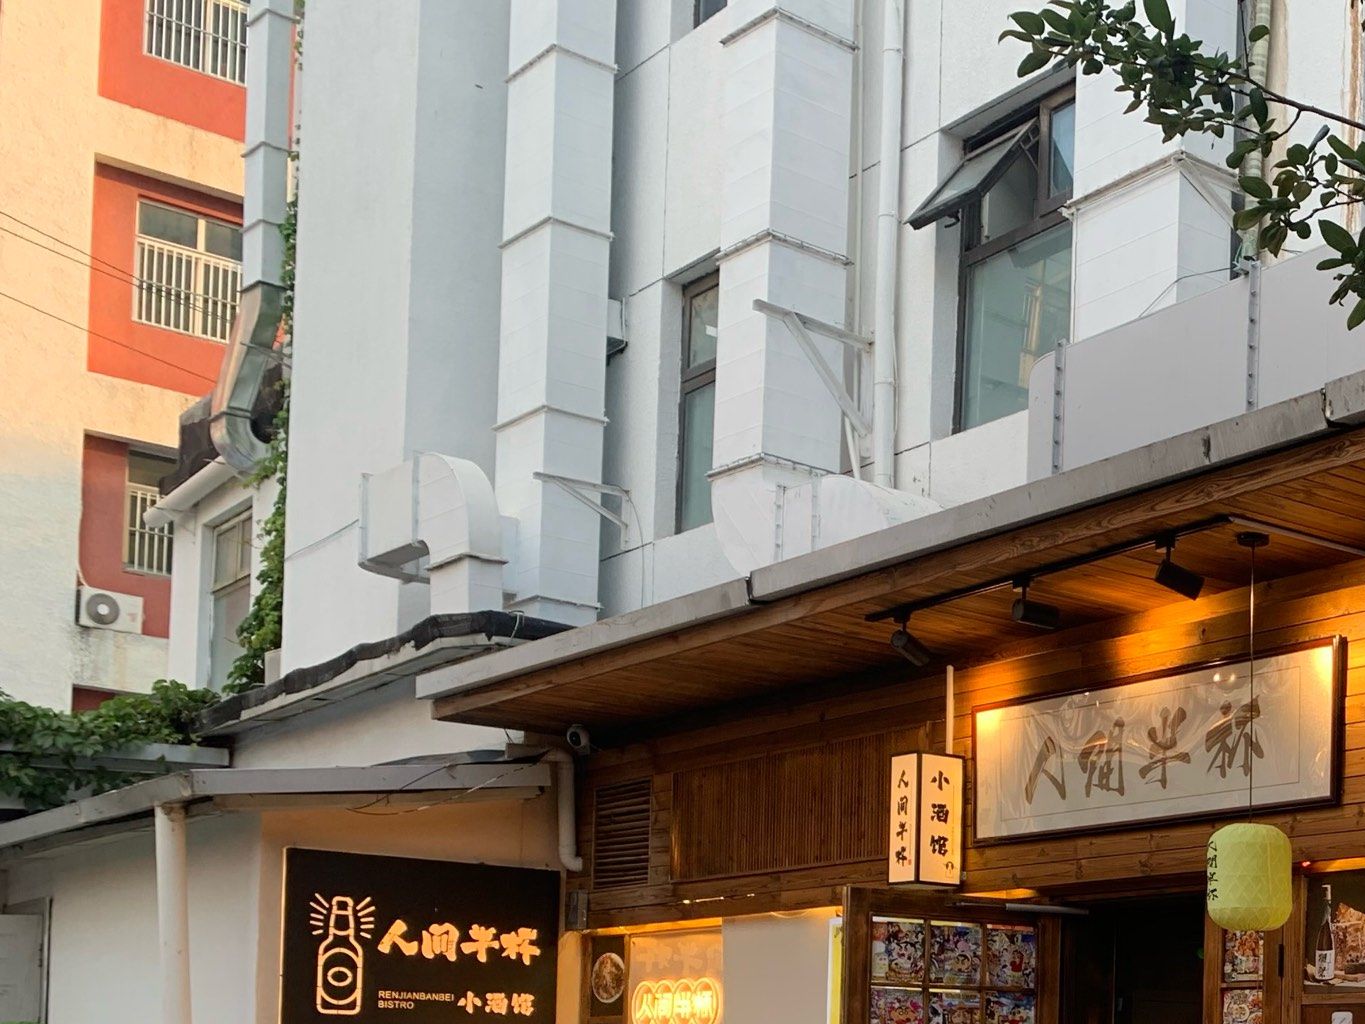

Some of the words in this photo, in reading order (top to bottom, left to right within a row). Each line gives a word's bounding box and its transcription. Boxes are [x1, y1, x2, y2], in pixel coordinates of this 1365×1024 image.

[895, 769, 909, 867] 人间半杯
[929, 770, 950, 857] 小酒馆
[377, 919, 541, 965] 人间半杯
[378, 990, 454, 1001] RENJIANBANBEI
[378, 1000, 414, 1010] BISTRO
[457, 991, 535, 1016] 小酒馆
